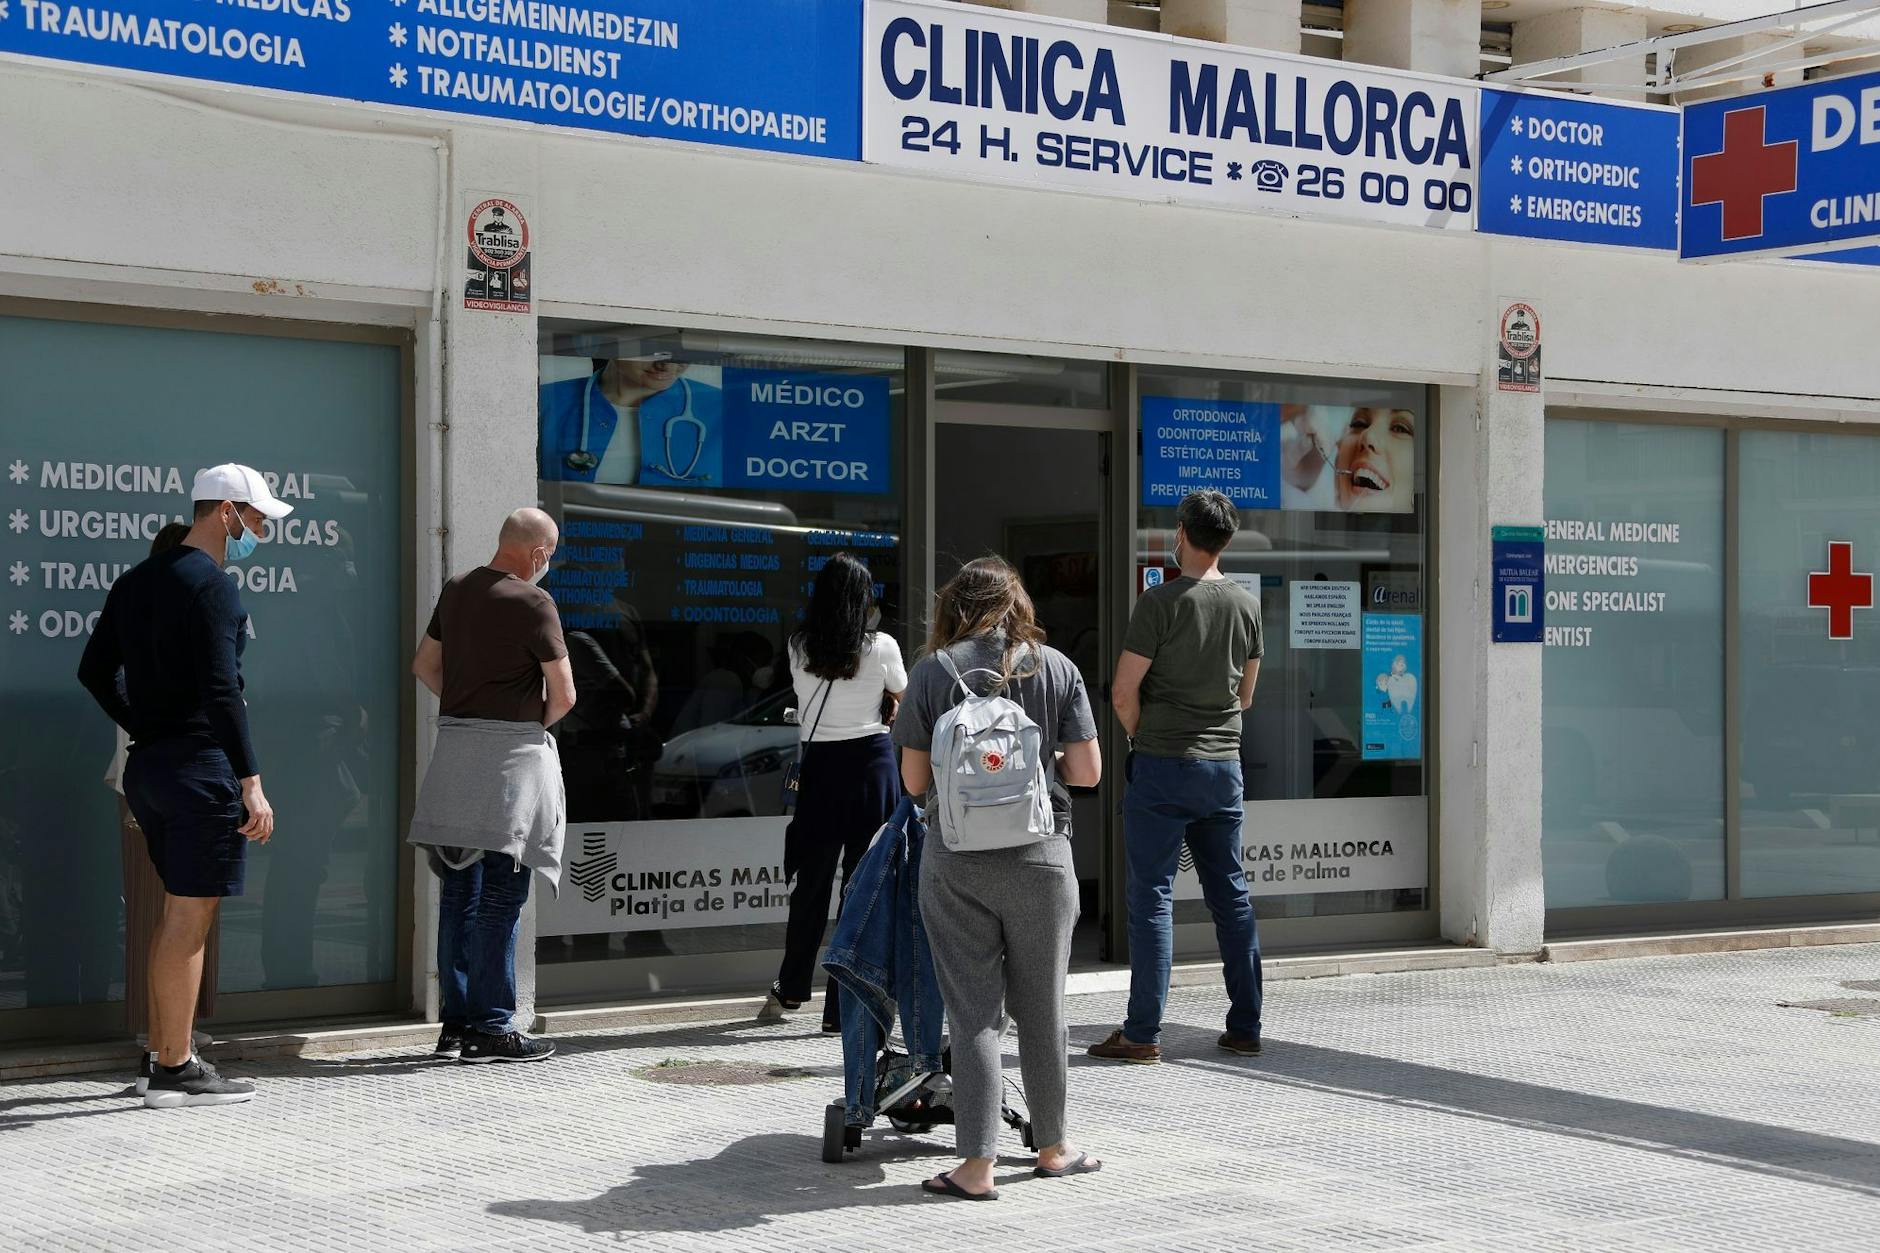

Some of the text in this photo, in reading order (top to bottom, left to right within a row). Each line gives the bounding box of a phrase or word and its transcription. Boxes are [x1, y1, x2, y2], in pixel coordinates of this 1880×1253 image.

[20, 0, 306, 68] TRAUMATOLOGIA
[417, 26, 621, 80] NOTFALLDIENST
[880, 17, 1471, 169] CLINICA MALLORCA
[418, 66, 827, 144] TRAUMATOLOGIE/ORTHOPAEDIE
[1528, 116, 1604, 147] DOCTOR
[901, 115, 1472, 214] 24 H. SERVICE 26 00 00
[1528, 156, 1640, 190] ORTHOPEDIC
[1527, 196, 1642, 228] EMERGENCIES
[476, 232, 519, 249] Trablisa
[466, 300, 529, 313] VIDEOVIGILANCIA
[751, 380, 865, 409] MÉDICO
[1172, 409, 1247, 424] ORTODONCIA
[769, 421, 846, 444] ARZT
[1157, 427, 1262, 444] ODONTOPEDIATRÍA
[1160, 445, 1259, 462] ESTÉTICA DENTAL
[40, 461, 184, 494] MEDICINA
[746, 457, 869, 482] DOCTOR
[1178, 466, 1241, 480] IMPLANTES
[1225, 486, 1268, 499] DENTAL
[40, 509, 194, 541] URGENCI
[684, 526, 728, 543] MEDICINA
[1610, 522, 1680, 543] MEDICINE
[685, 553, 780, 571] URGENCIAS MEDICAS
[1544, 554, 1638, 576] MERGENCIES
[685, 580, 763, 597] TRAUMATOLOGIA
[1545, 590, 1665, 612] ONE SPECIALIST
[684, 606, 779, 624] ODONTOLOGIA
[1545, 626, 1592, 647] ENTIST
[1290, 840, 1394, 860] MALLORCA
[611, 868, 722, 892] CLINICAS
[1262, 863, 1286, 881] de
[1292, 862, 1350, 880] Palma
[610, 888, 791, 919] Platja de Palm
